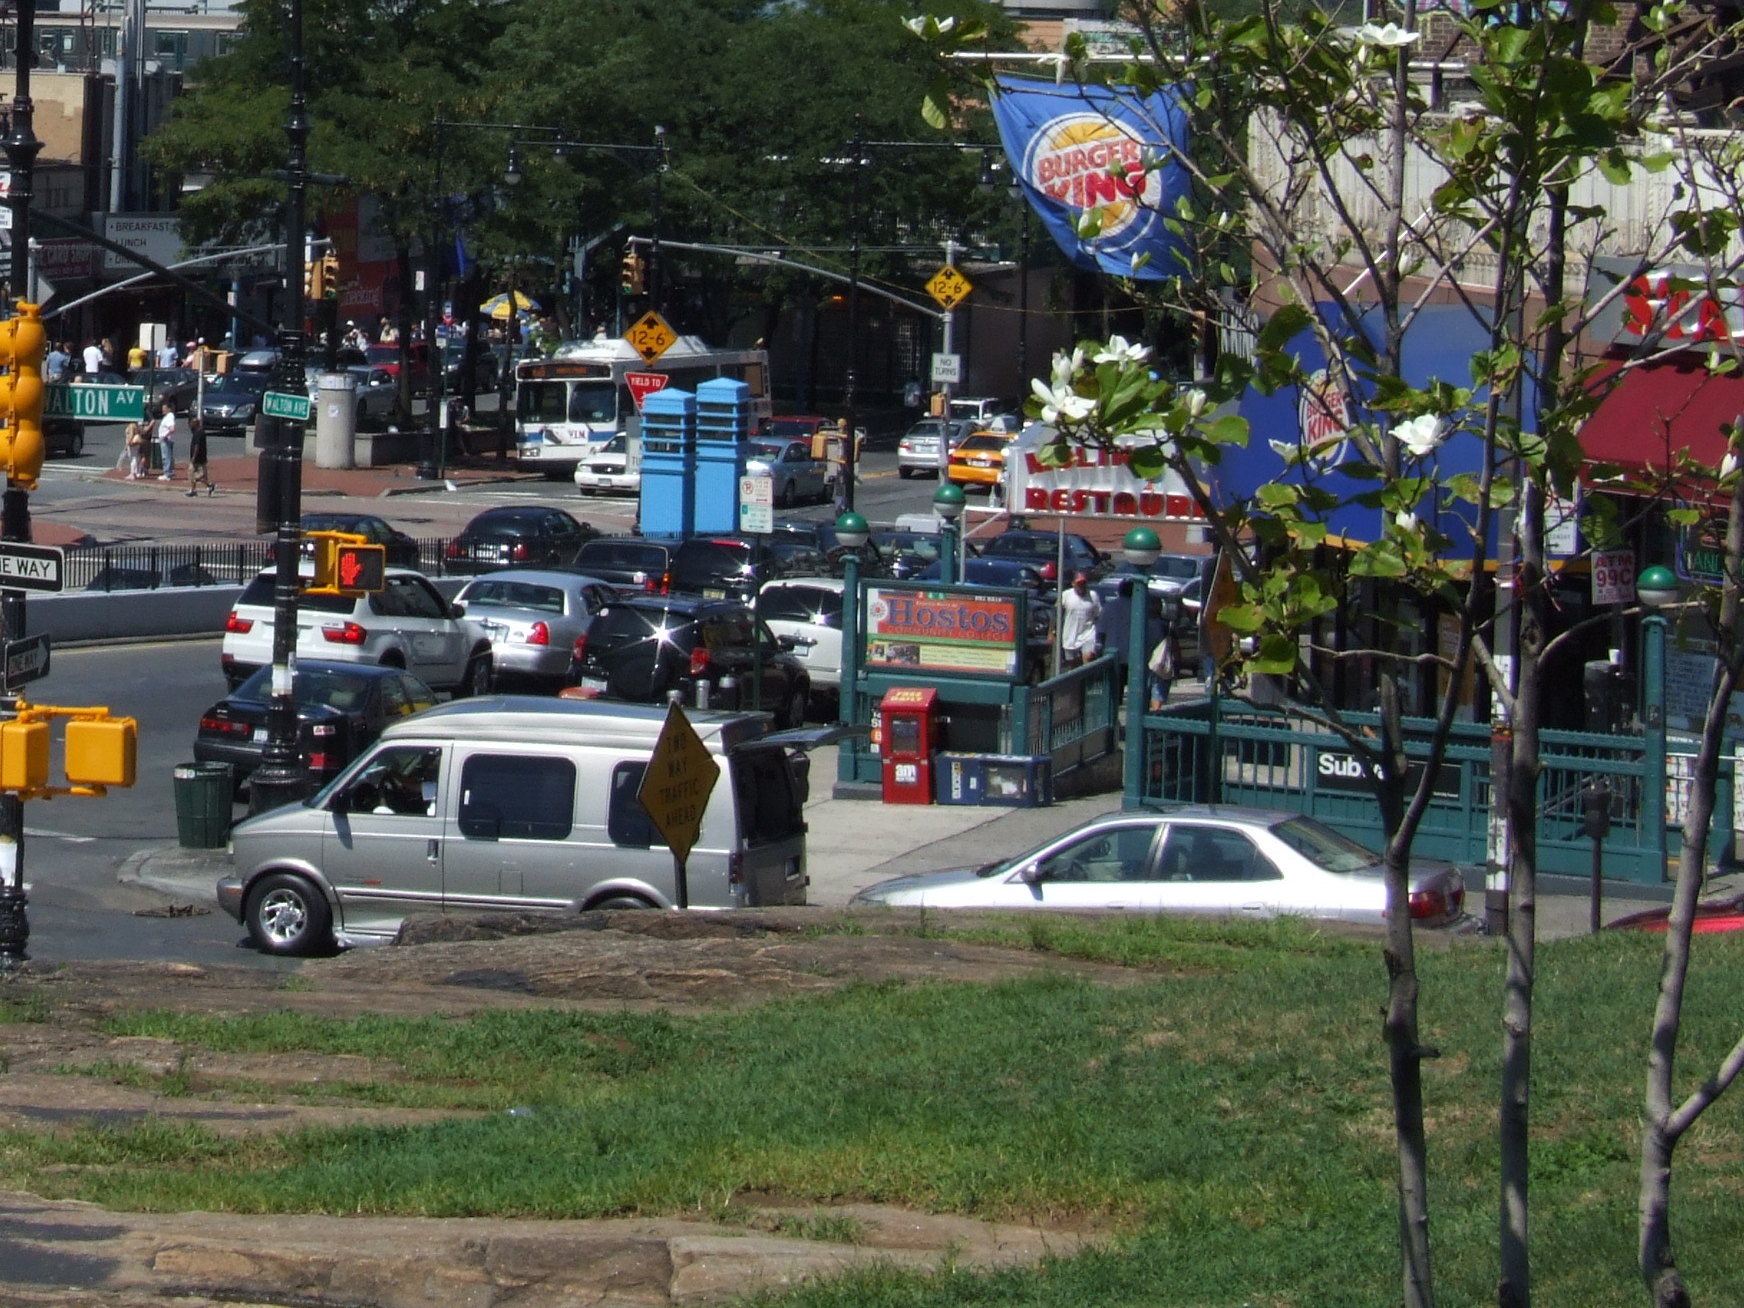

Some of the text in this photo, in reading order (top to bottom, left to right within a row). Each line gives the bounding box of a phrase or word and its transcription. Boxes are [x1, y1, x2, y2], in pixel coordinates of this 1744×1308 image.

[1037, 138, 1141, 185] BURGER
[1044, 161, 1149, 209] KING
[116, 222, 169, 232] BREAKFAST
[935, 366, 958, 378] TURNS
[939, 358, 953, 368] NO
[630, 376, 661, 387] YIELD TO
[116, 390, 136, 405] AV
[266, 397, 293, 413] WALTON
[16, 558, 51, 578] WAY
[1595, 552, 1634, 568] ATM
[886, 598, 1010, 634] Hostos
[666, 732, 687, 754] TWO
[667, 756, 688, 779] WAY
[659, 777, 699, 805] TRAFFIC
[665, 804, 697, 829] AHEAD
